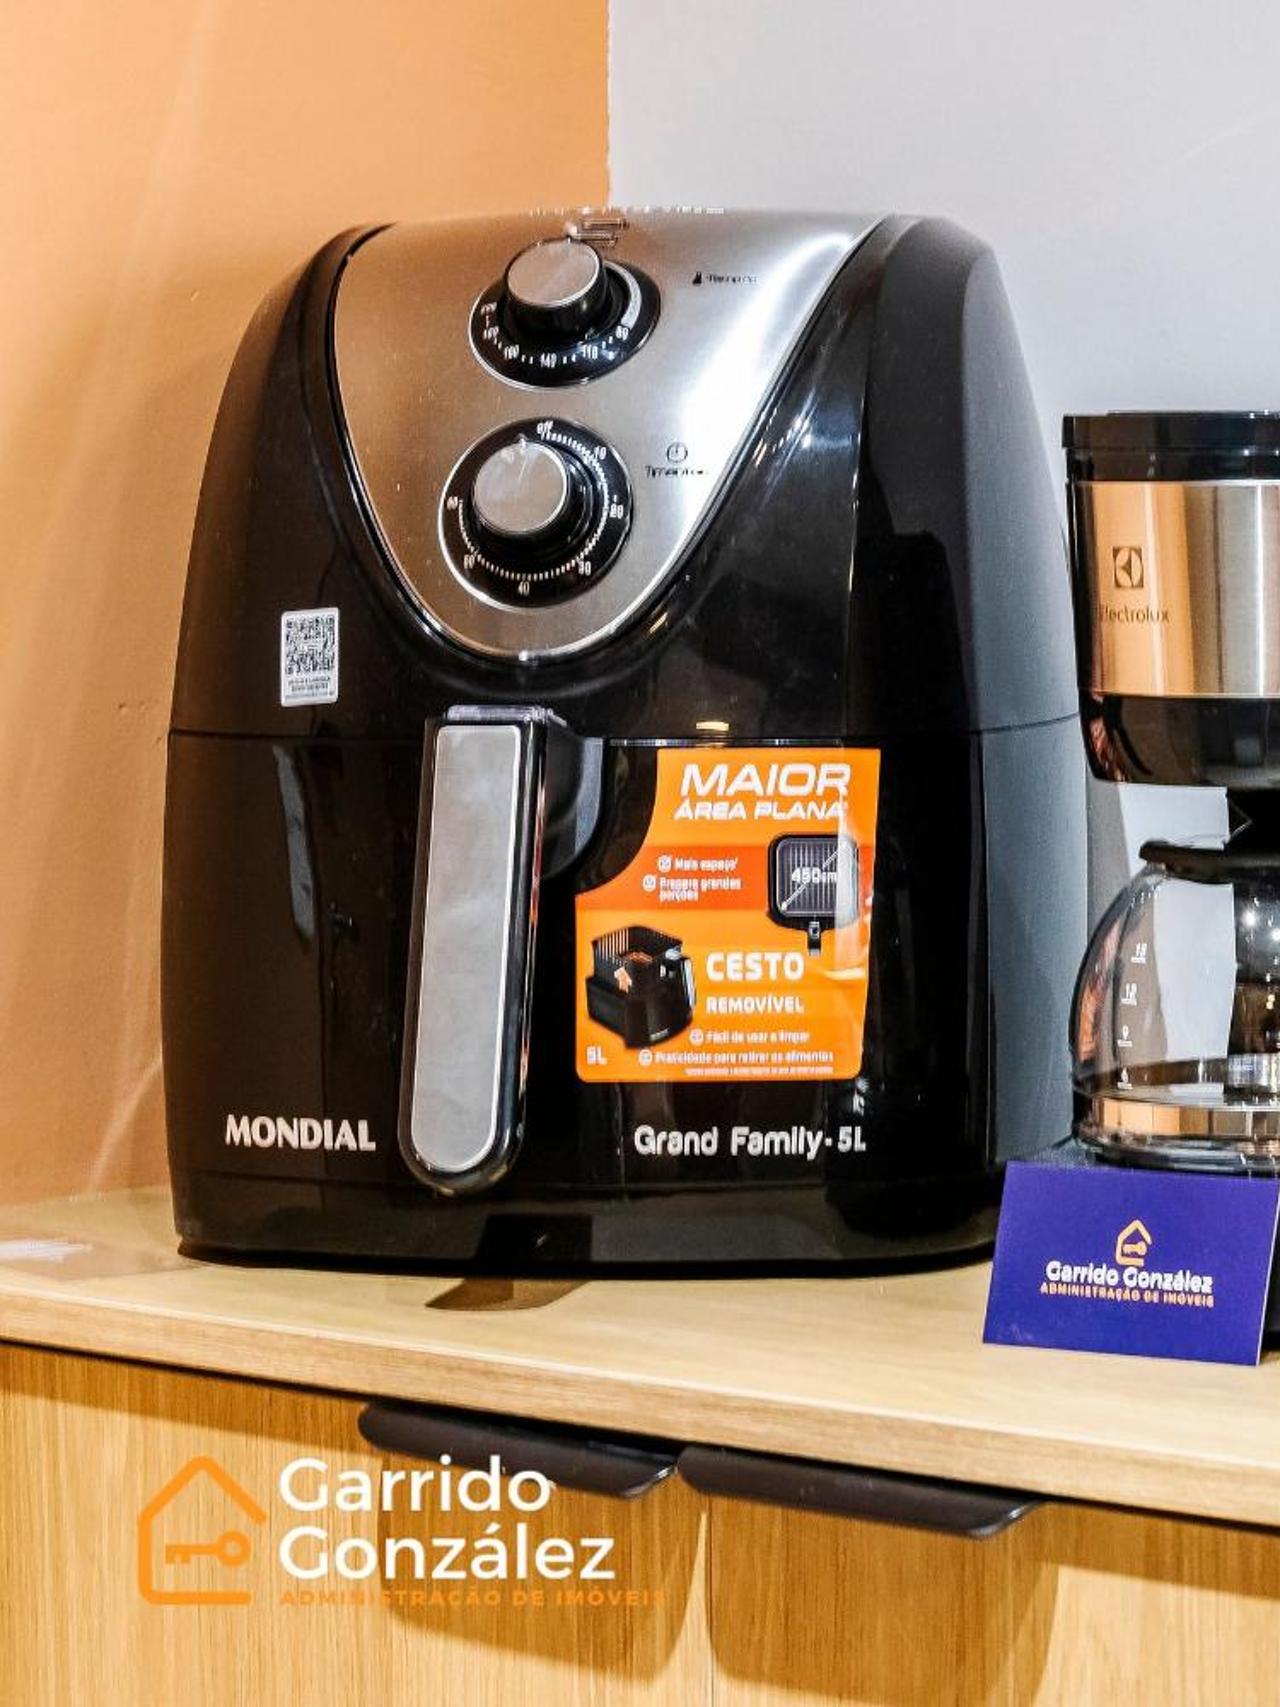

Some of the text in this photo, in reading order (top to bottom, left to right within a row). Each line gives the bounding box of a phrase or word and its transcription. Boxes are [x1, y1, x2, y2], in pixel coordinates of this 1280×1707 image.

[517, 581, 530, 595] 40
[680, 763, 852, 797] MAIOR
[674, 796, 848, 821] ÁREA PLANA
[705, 952, 805, 982] CESTO
[706, 994, 804, 1014] REMOVÍVEL
[225, 1113, 376, 1152] MONDIAL
[634, 1123, 718, 1155] Grand
[1045, 1260, 1213, 1293] Garrido González
[1040, 1282, 1214, 1308] ADMINISTRAÇÃO DE IMÓVEIS
